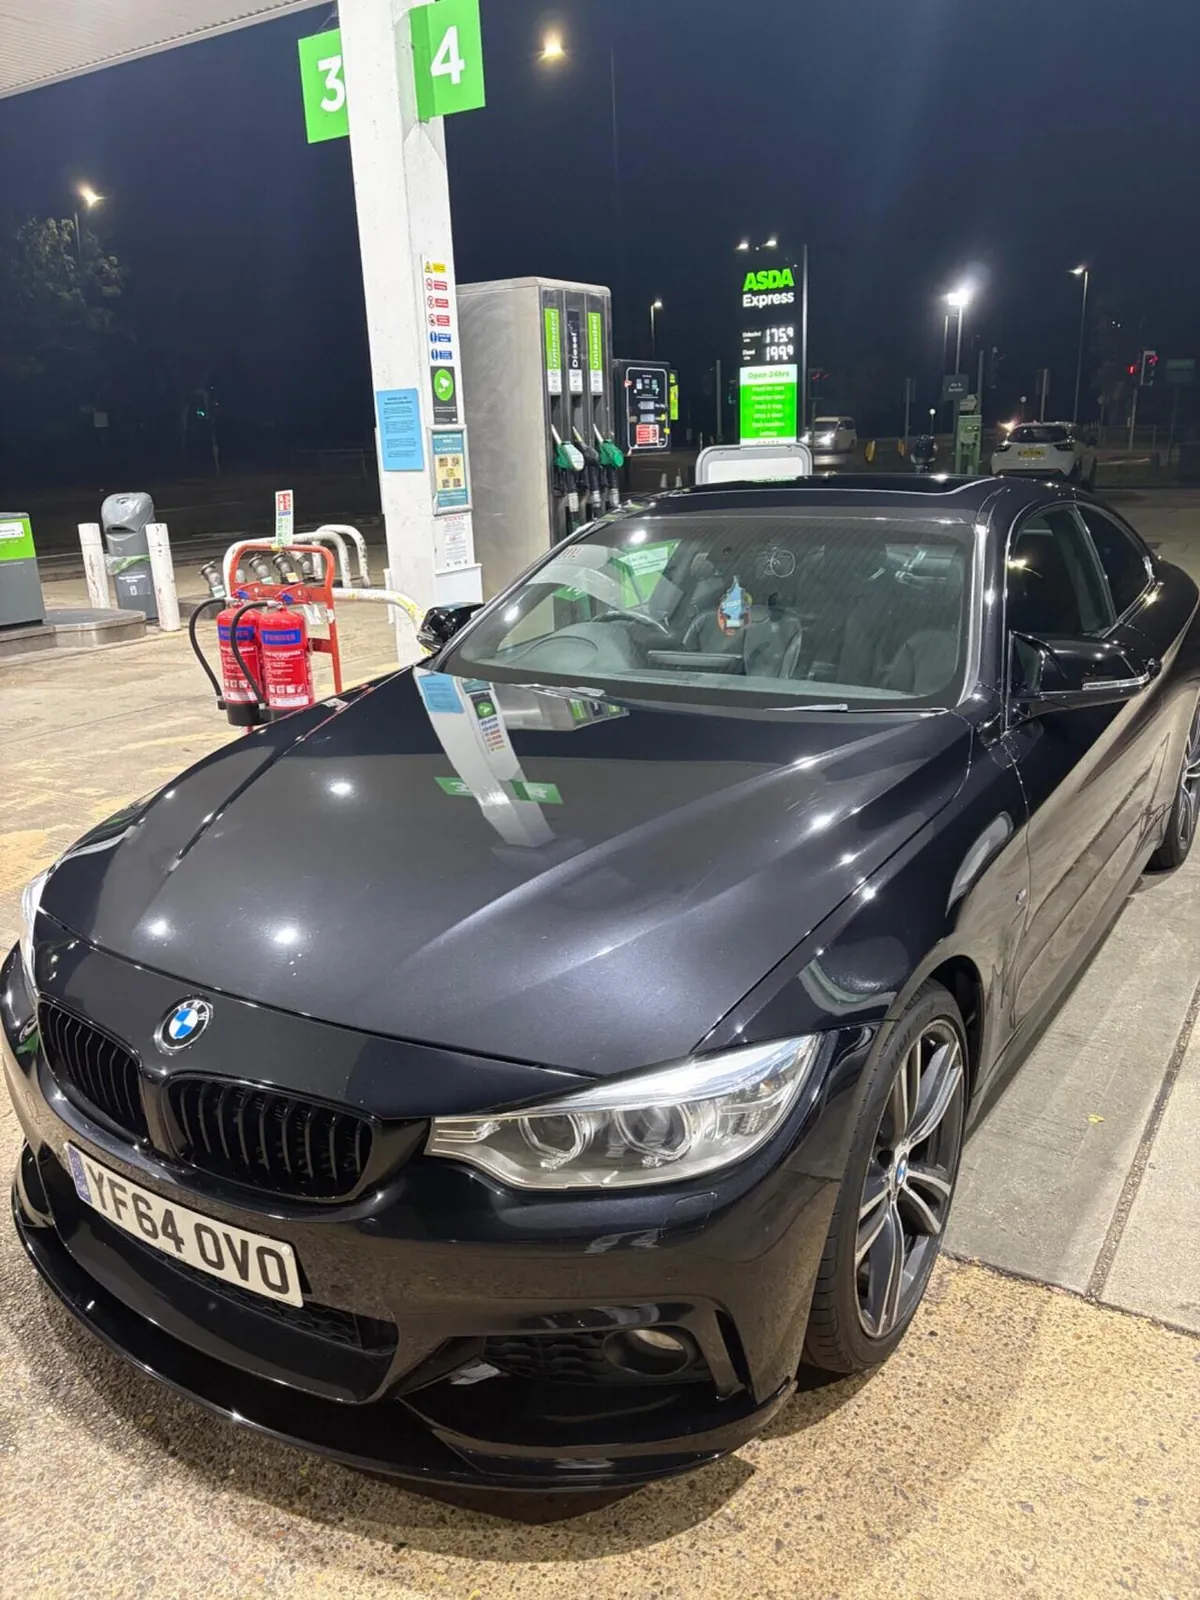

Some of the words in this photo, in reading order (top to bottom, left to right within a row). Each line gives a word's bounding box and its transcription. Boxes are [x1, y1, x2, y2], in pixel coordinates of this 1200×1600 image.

[430, 25, 465, 84] 4
[317, 55, 346, 112] 3
[743, 268, 795, 291] ASDA
[743, 293, 795, 309] Express
[571, 332, 579, 368] Diesel
[86, 1162, 185, 1254] YF64
